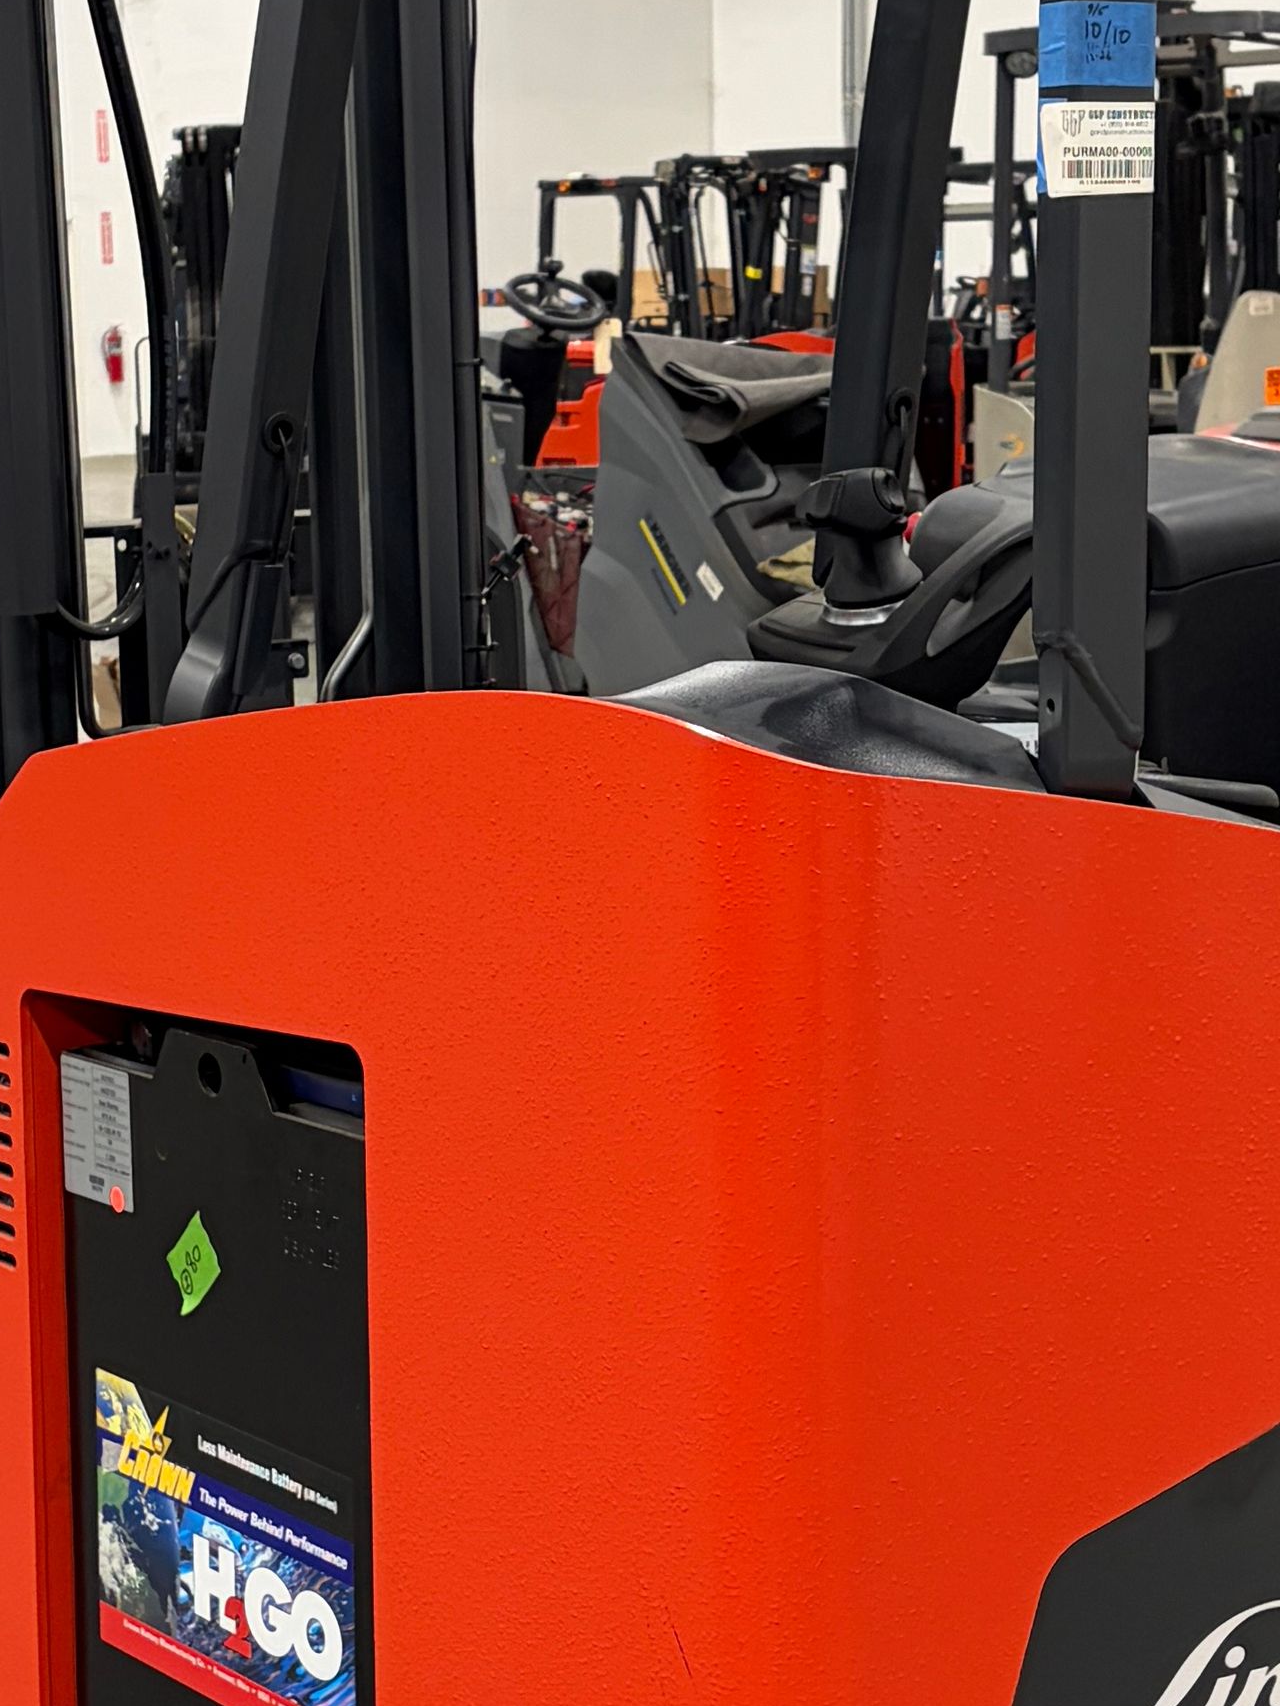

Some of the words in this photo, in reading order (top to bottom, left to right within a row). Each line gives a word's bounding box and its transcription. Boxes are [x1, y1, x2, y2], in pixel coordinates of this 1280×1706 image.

[1085, 19, 1132, 48] 10/10
[117, 1430, 196, 1505] CROWN
[197, 1434, 217, 1458] Less
[217, 1443, 271, 1482] Maintenance
[271, 1467, 303, 1500] Battery
[198, 1487, 217, 1508] The
[218, 1496, 249, 1523] Power
[250, 1511, 284, 1539] Behind
[284, 1526, 349, 1571] Performance
[192, 1533, 344, 1683] H2GO
